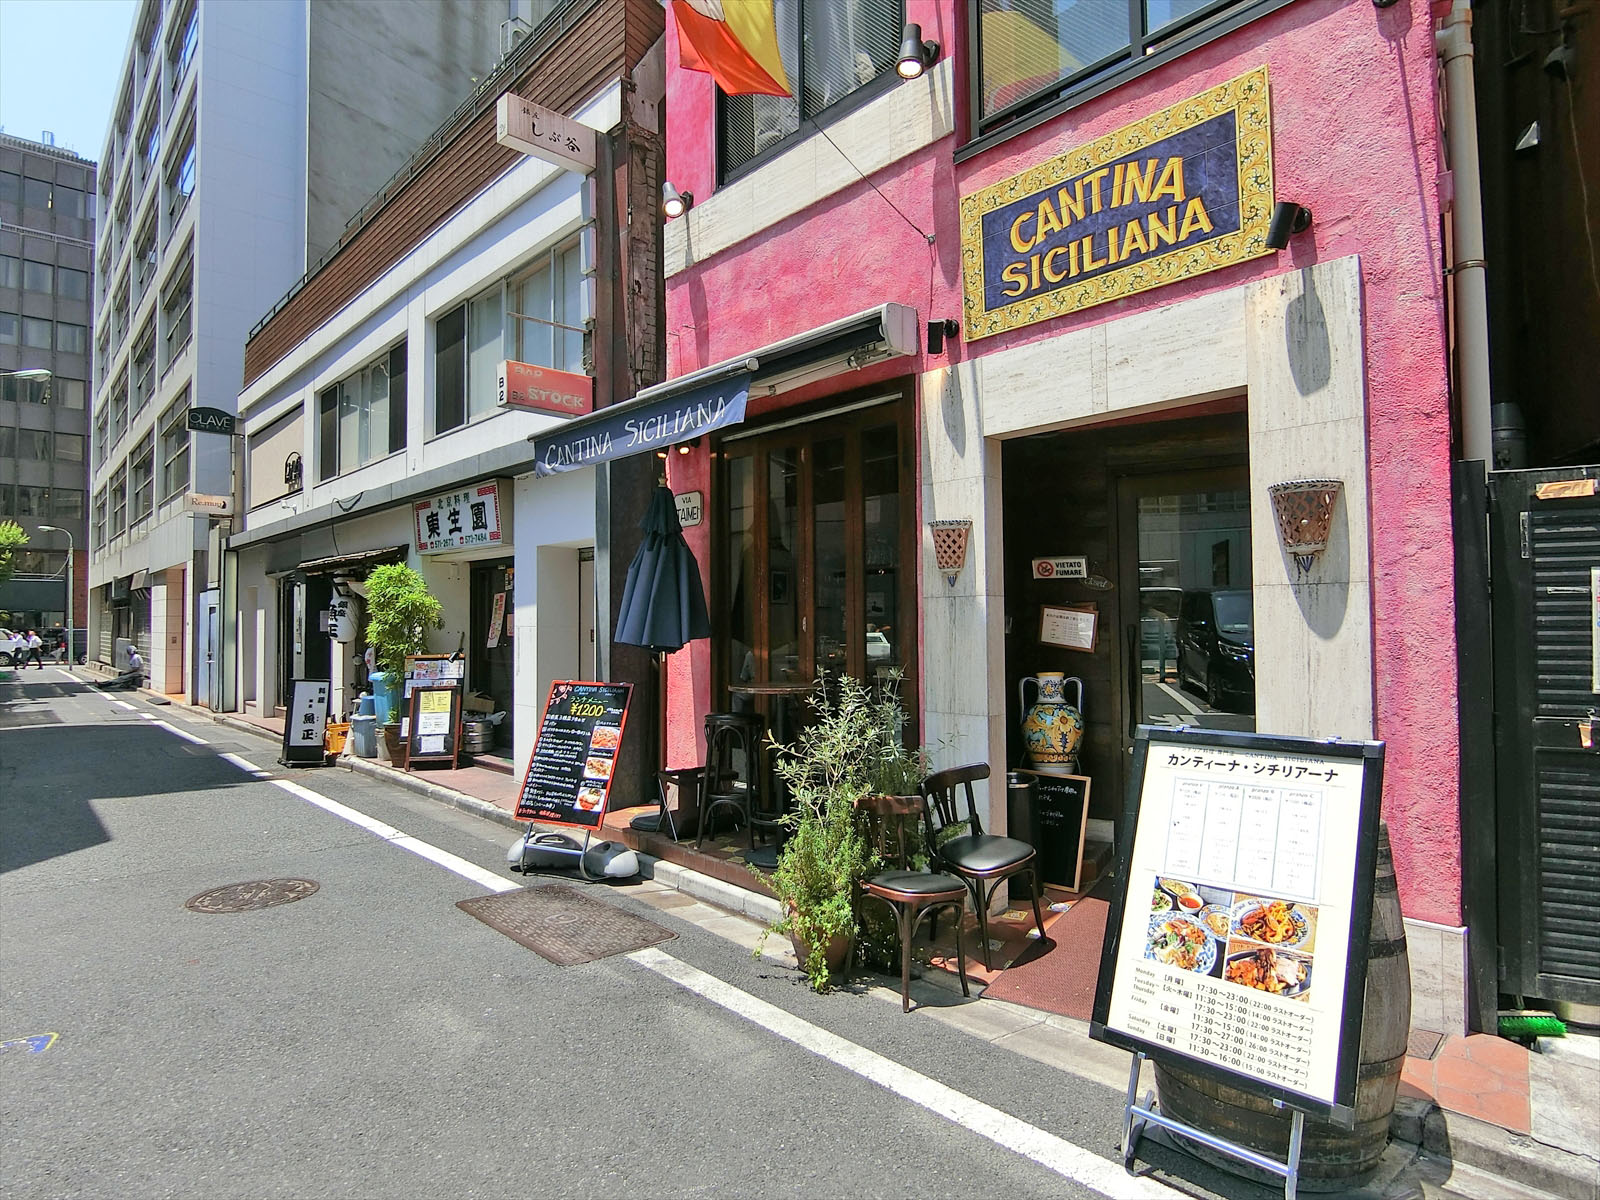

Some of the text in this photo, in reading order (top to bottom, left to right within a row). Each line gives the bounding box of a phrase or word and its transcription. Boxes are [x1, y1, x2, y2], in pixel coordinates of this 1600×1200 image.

[1008, 156, 1186, 254] CANTINA
[1000, 196, 1214, 297] SICILIANA
[528, 386, 584, 408] STOCK
[190, 412, 231, 428] CLAVE
[544, 396, 726, 470] CANTINA SICILIANA
[426, 501, 488, 539] 東生園
[1168, 754, 1338, 782] カンティーナ・シチリアーナ
[1136, 967, 1155, 977] Monday
[1134, 984, 1155, 995] Thursday
[1131, 995, 1147, 1005] Friday
[1127, 1024, 1145, 1034] Sunday
[1128, 1014, 1150, 1026] Saturday
